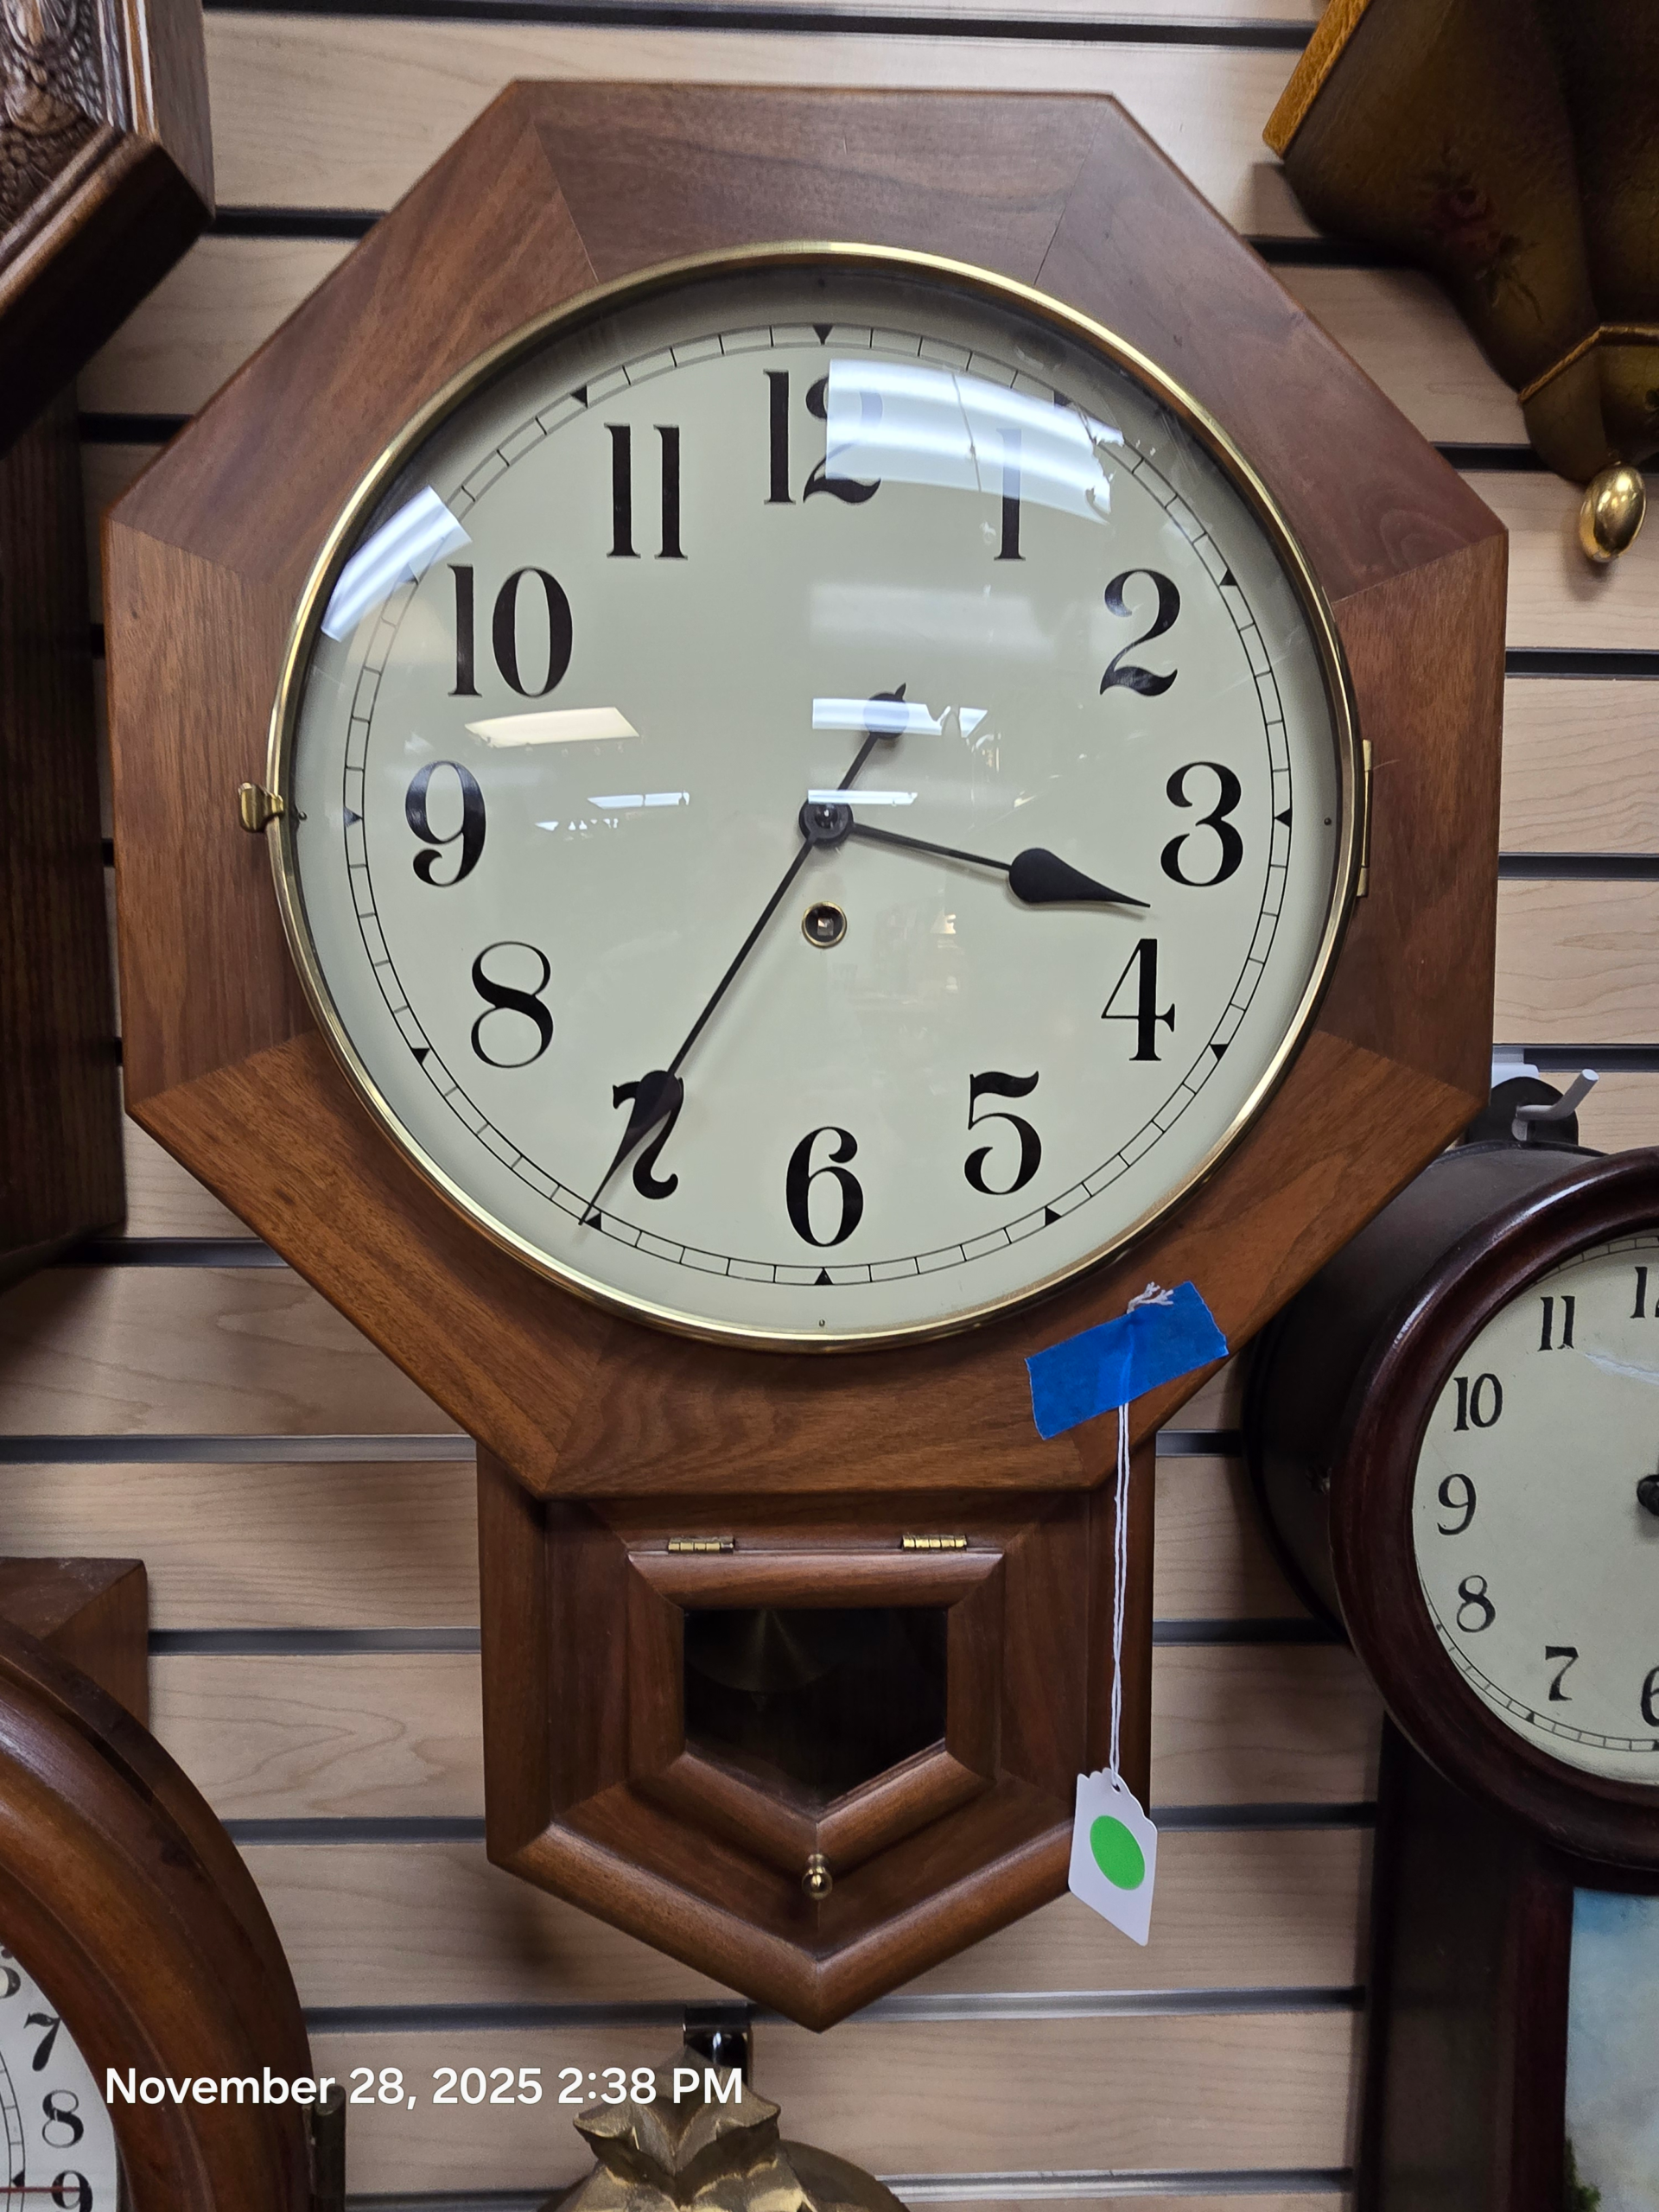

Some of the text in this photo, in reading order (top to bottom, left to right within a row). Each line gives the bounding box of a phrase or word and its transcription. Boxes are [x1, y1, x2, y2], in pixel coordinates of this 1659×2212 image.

[604, 423, 688, 560] 11
[763, 369, 883, 505] 12
[994, 428, 1026, 561] 1
[448, 564, 573, 698] 10
[1100, 569, 1180, 697] 2
[405, 760, 486, 887] 9
[1160, 761, 1244, 887] 3
[470, 941, 554, 1069] 8
[1101, 938, 1176, 1062] 4
[613, 1073, 683, 1199] 7
[786, 1126, 864, 1248] 6
[964, 1071, 1042, 1196] 5
[1537, 1295, 1575, 1351] 11
[1630, 1266, 1659, 1319] 1
[1453, 1372, 1503, 1432] 10
[1438, 1474, 1477, 1536] 9
[1456, 1574, 1496, 1633] 8
[1545, 1646, 1579, 1701] 7
[24, 2012, 60, 2071] 7
[41, 2089, 84, 2148] 8
[52, 2170, 92, 2212] 9
